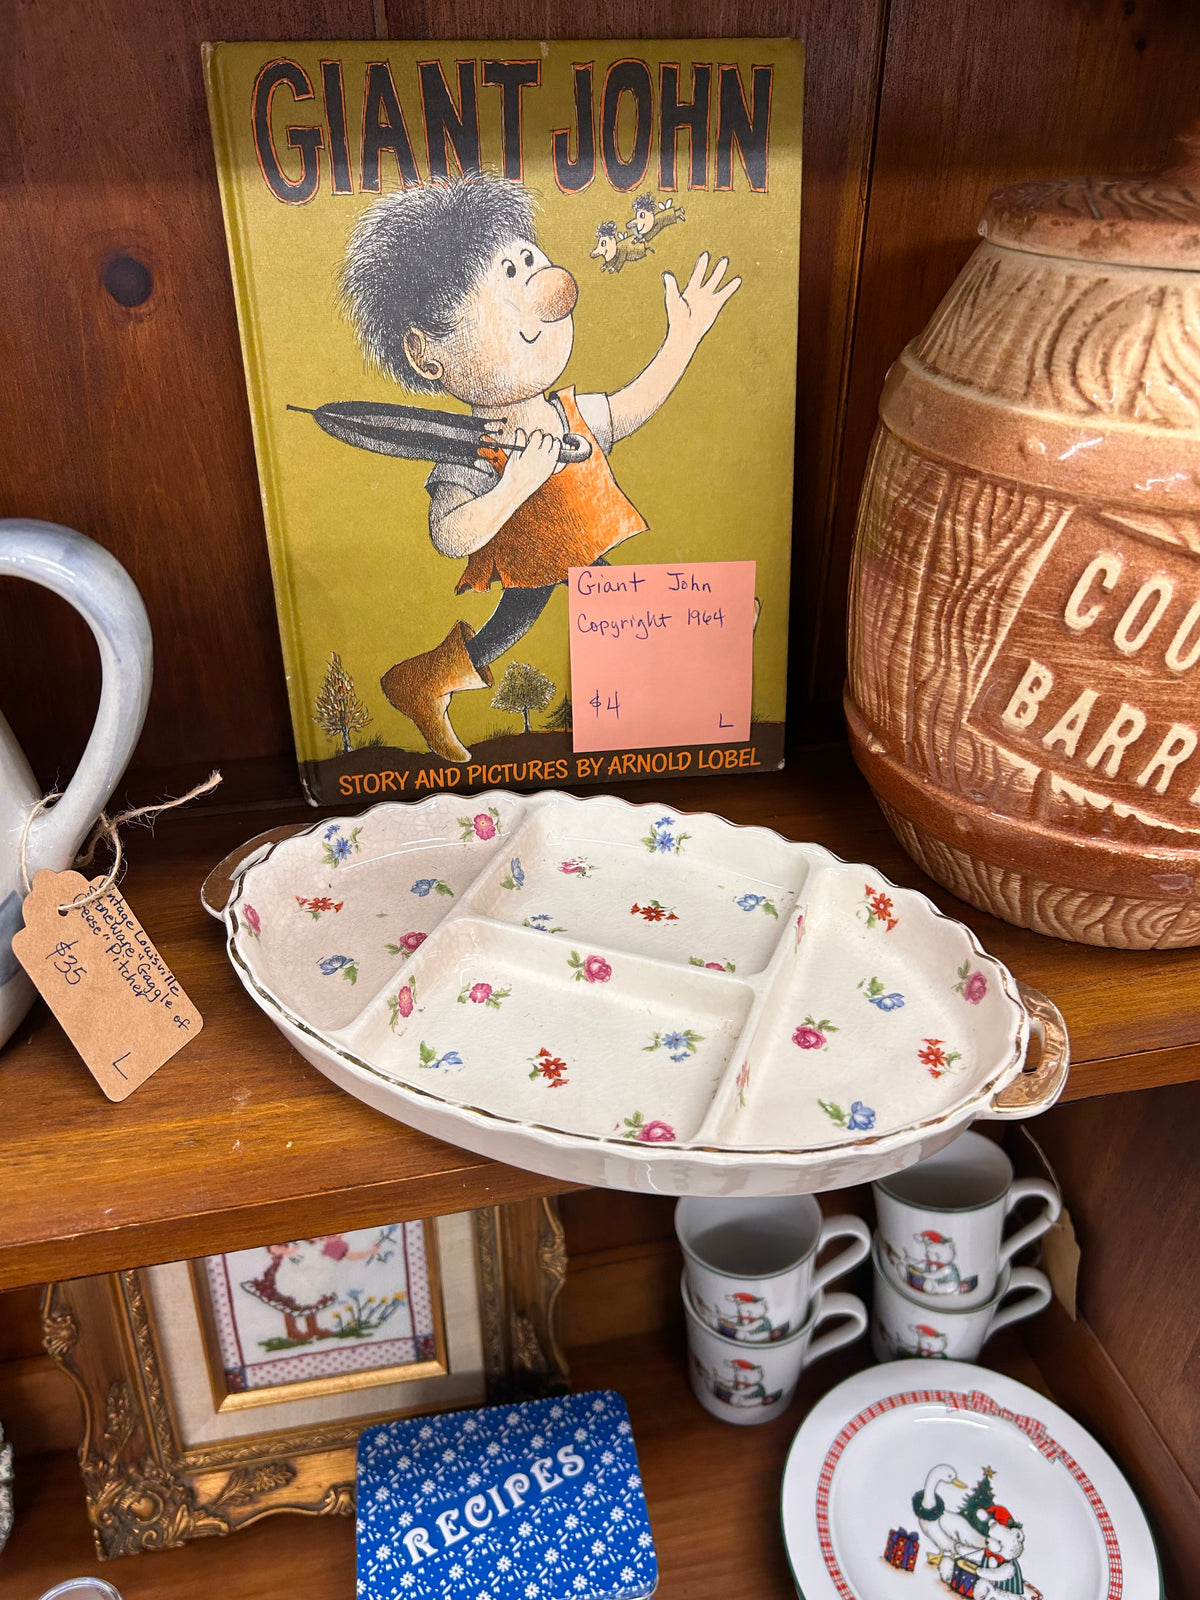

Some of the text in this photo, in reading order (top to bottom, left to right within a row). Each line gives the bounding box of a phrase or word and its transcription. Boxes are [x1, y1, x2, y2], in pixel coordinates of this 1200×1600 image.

[251, 57, 775, 206] GIANT JOHN
[577, 570, 712, 596] Giant John
[577, 608, 726, 640] Copyright 1964
[589, 689, 621, 720] $4
[718, 713, 734, 728] L
[1001, 659, 1200, 805] BARR
[339, 747, 761, 796] STORY AND PICTURES BY ARNOLD LOBEL
[45, 940, 88, 986] $35
[105, 943, 156, 1003] Pitcher
[134, 929, 180, 998] Louisville
[173, 1014, 190, 1031] of
[402, 1443, 586, 1567] RECIPES
